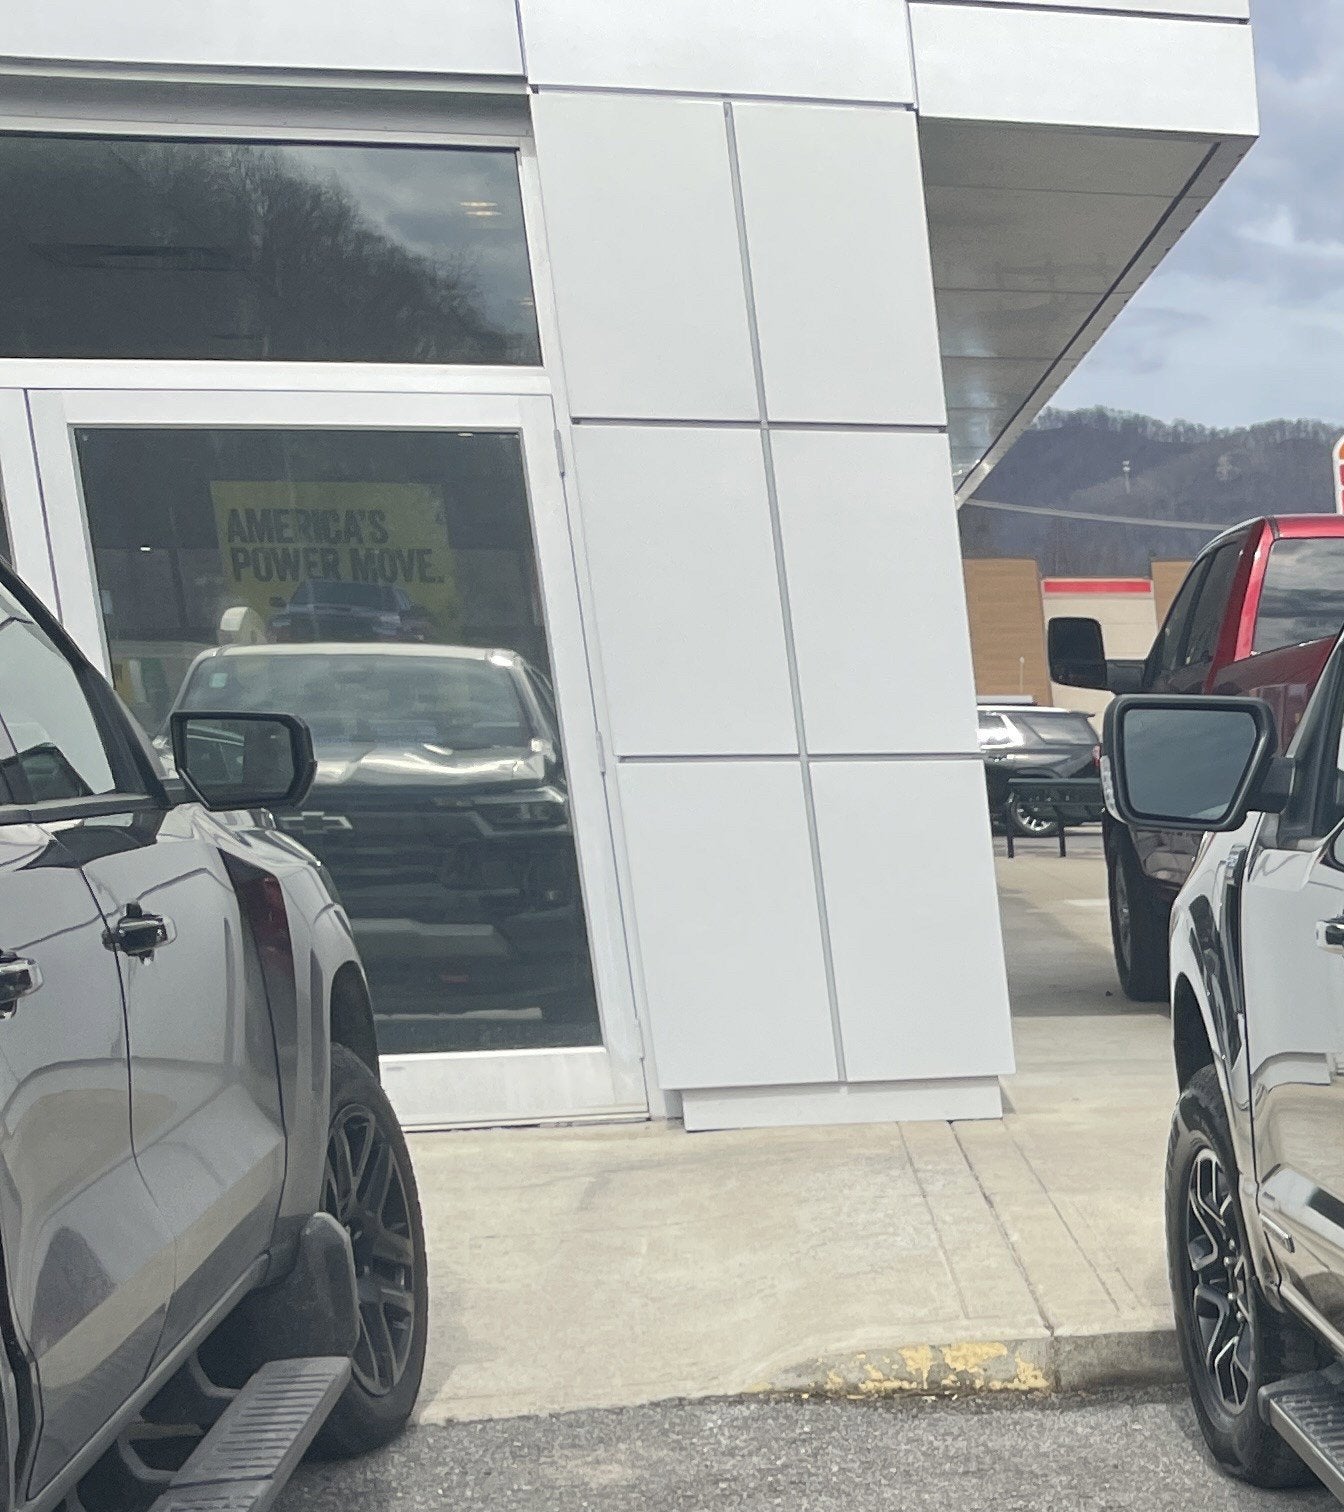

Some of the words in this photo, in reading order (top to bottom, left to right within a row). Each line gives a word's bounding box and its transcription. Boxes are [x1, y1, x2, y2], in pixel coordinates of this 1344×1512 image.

[228, 508, 388, 543] AMERICA'S
[230, 547, 341, 582] POWER
[350, 548, 445, 583] MOVE.
